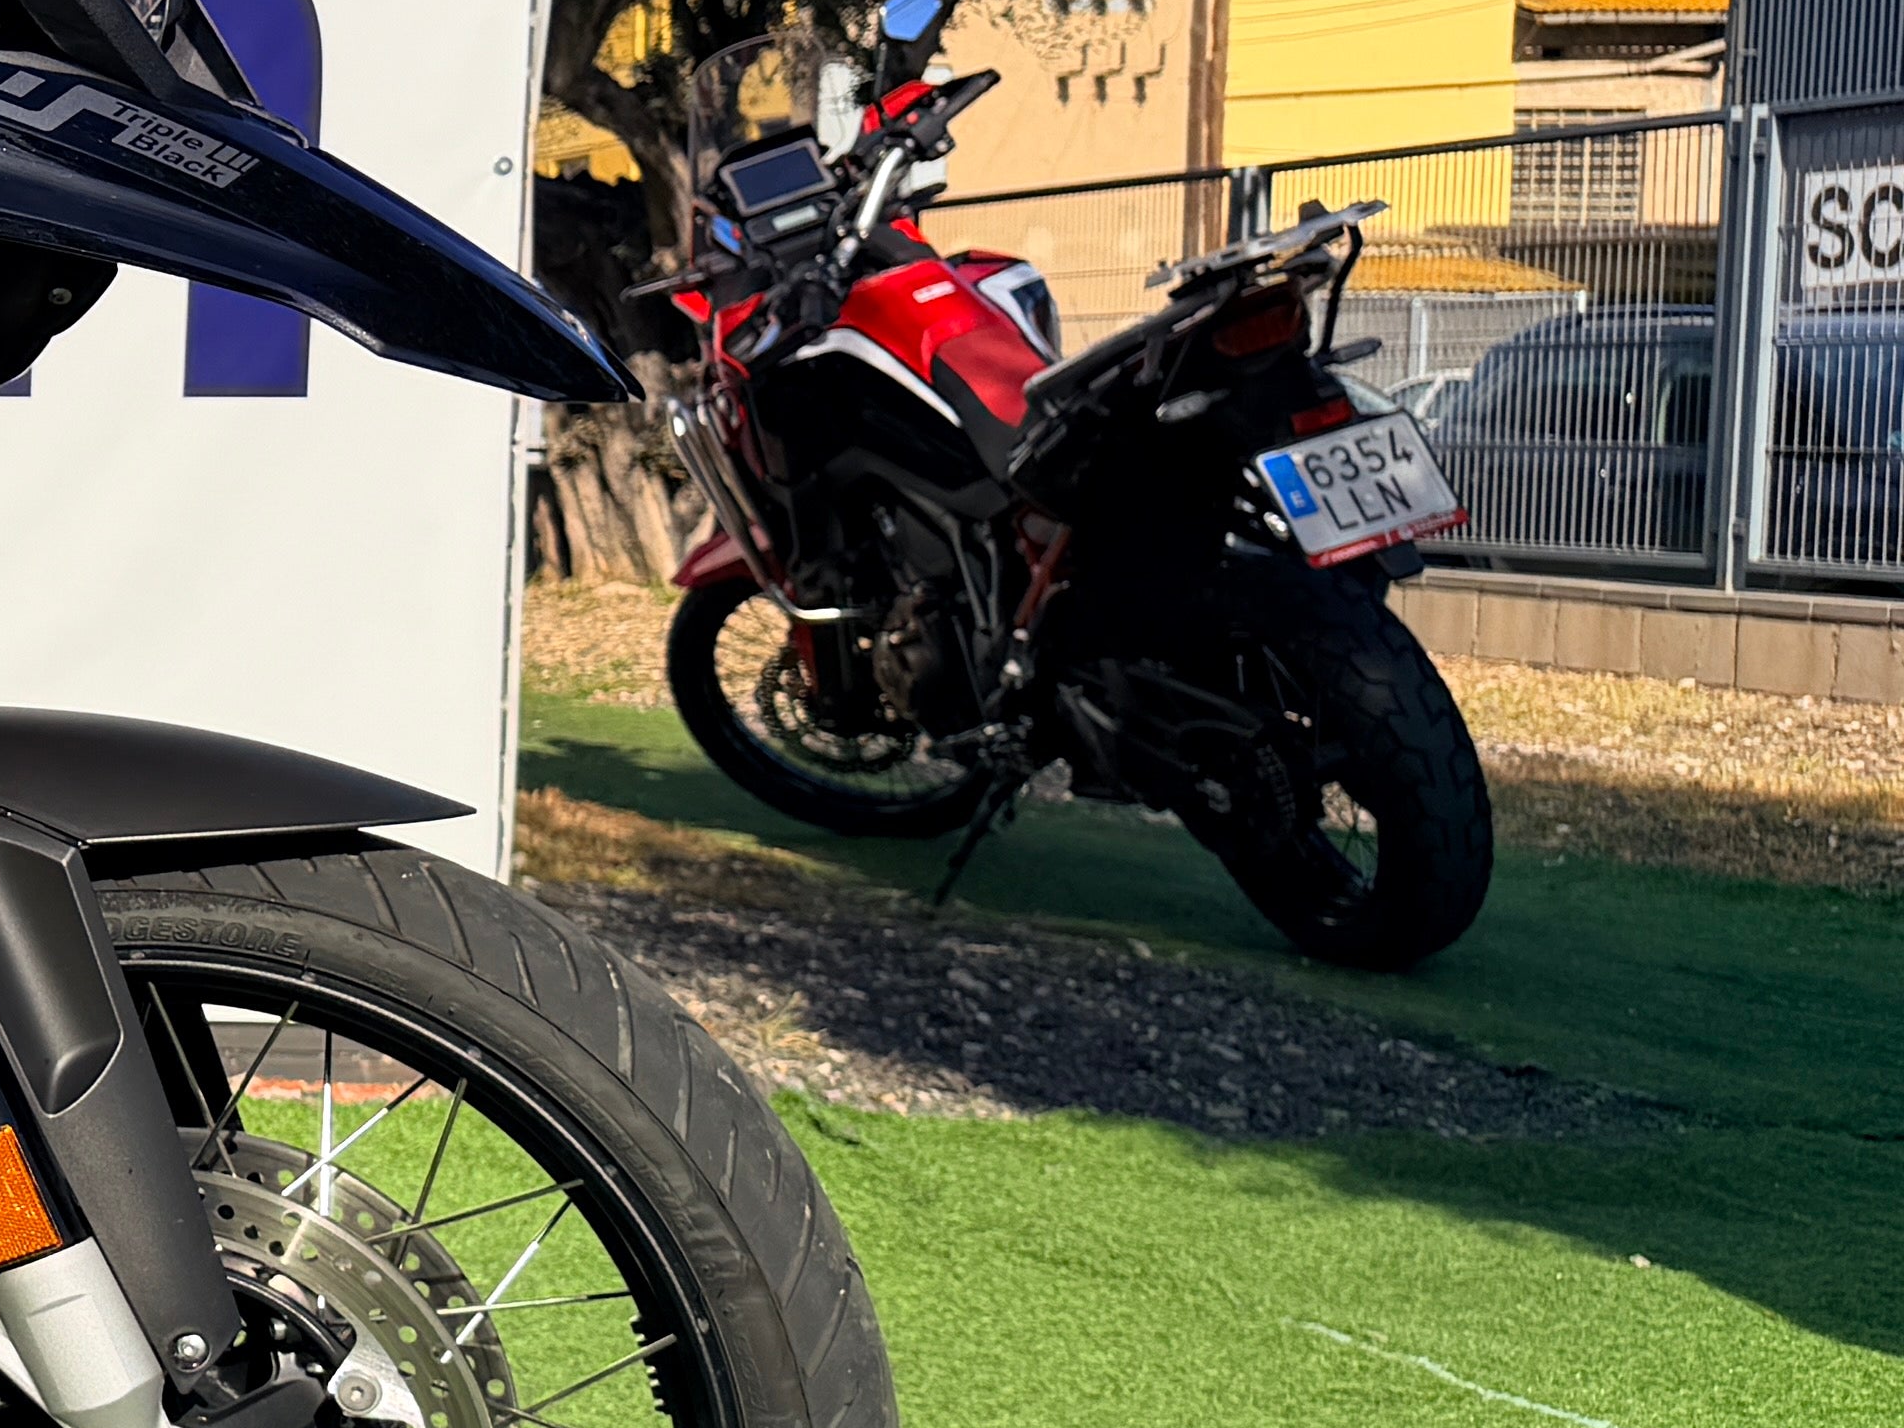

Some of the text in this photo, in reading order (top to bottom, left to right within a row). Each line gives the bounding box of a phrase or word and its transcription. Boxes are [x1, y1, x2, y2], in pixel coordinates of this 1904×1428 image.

[111, 101, 204, 151] Triple
[127, 132, 225, 183] Black
[1304, 427, 1414, 489] 6354
[1321, 473, 1413, 531] LLN
